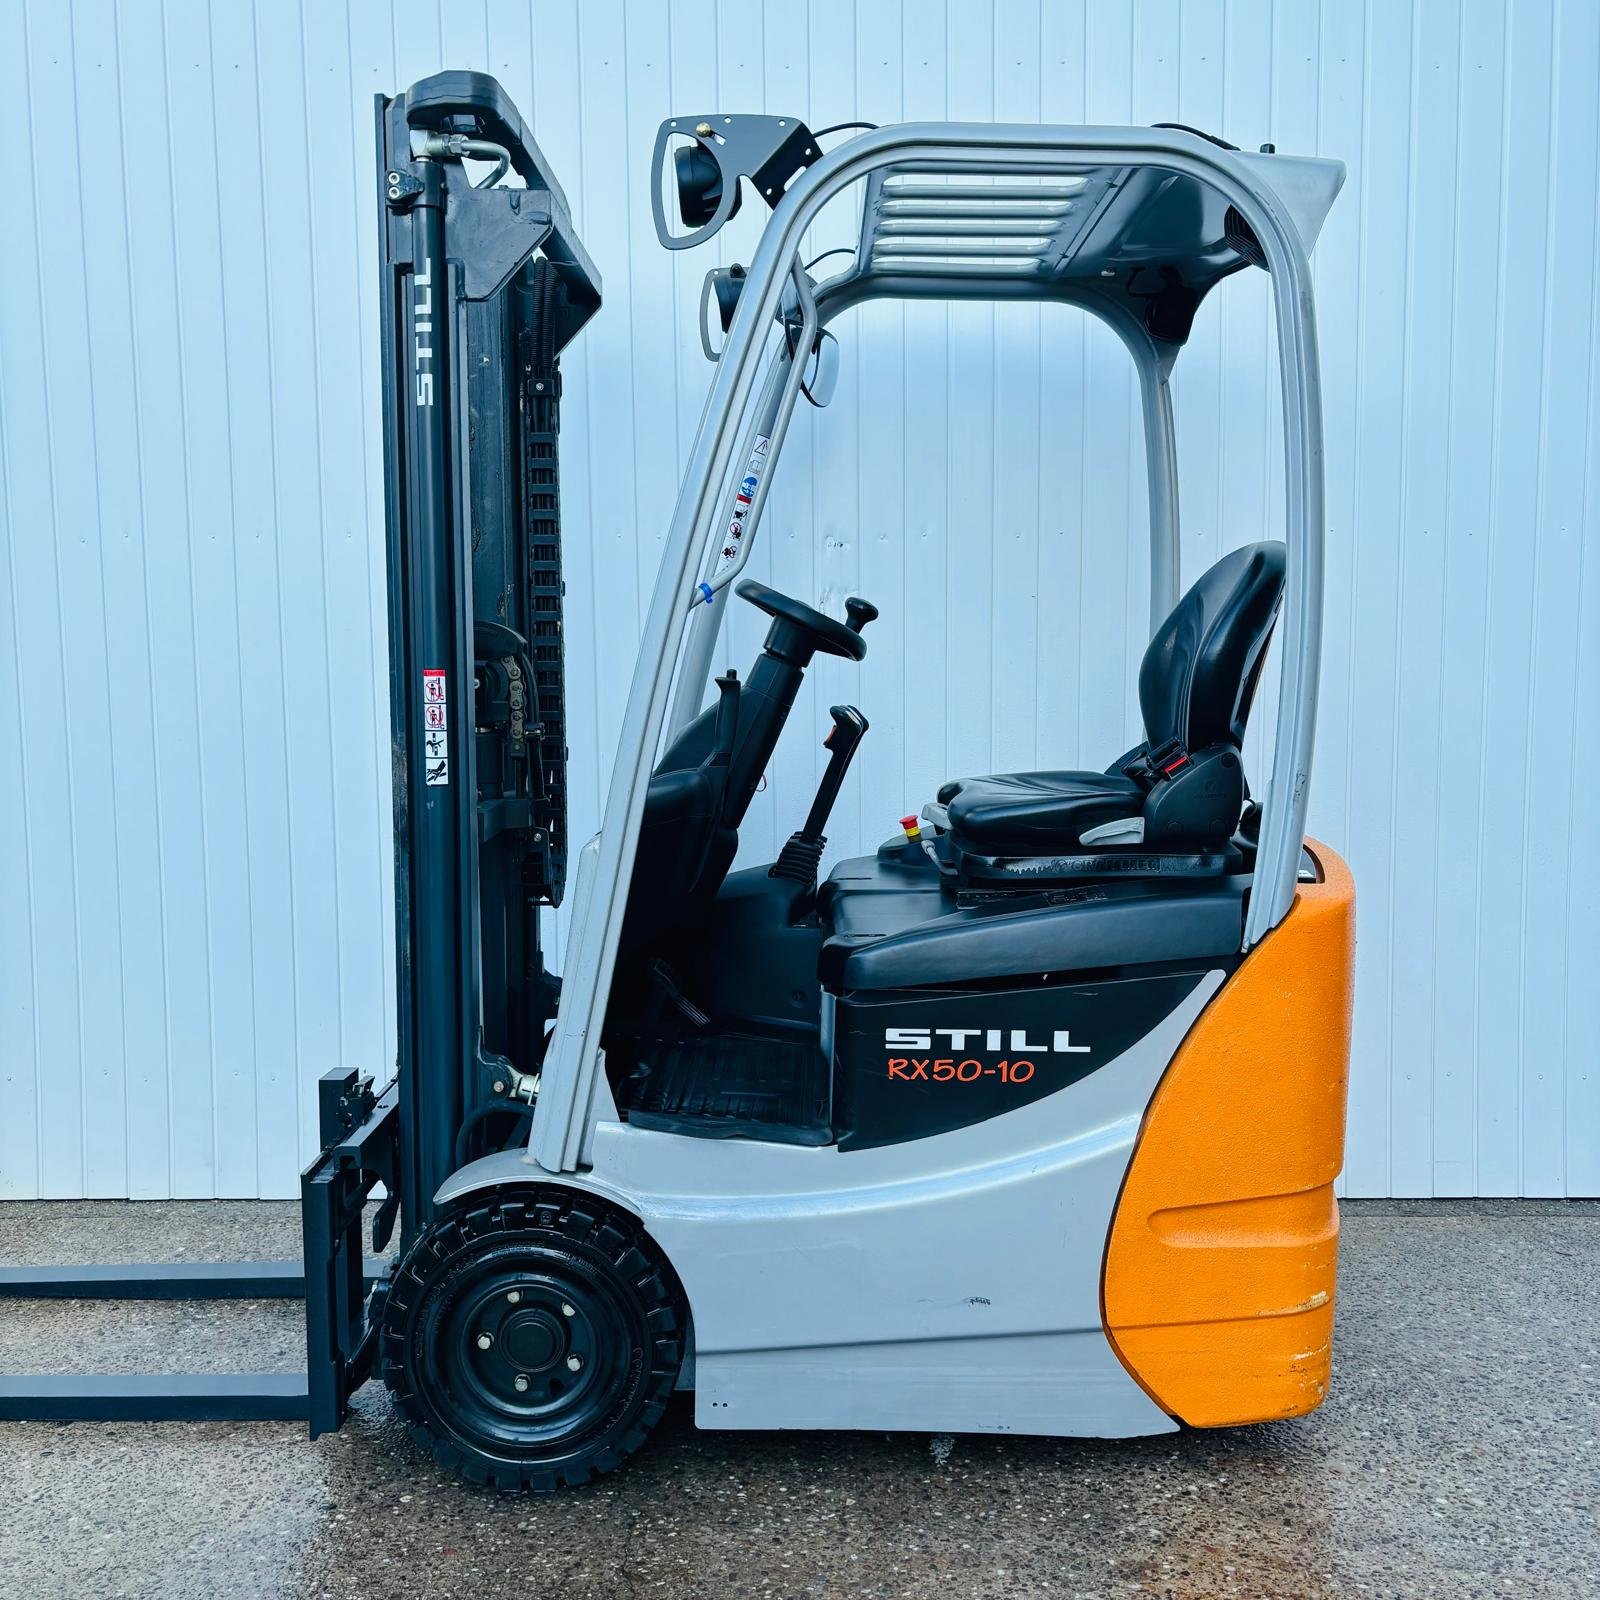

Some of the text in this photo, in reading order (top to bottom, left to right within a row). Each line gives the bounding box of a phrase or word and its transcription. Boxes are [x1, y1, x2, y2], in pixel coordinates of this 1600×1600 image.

[414, 257, 434, 406] STILL
[885, 1028, 1091, 1052] STILL
[888, 1058, 1035, 1083] RX50-10
